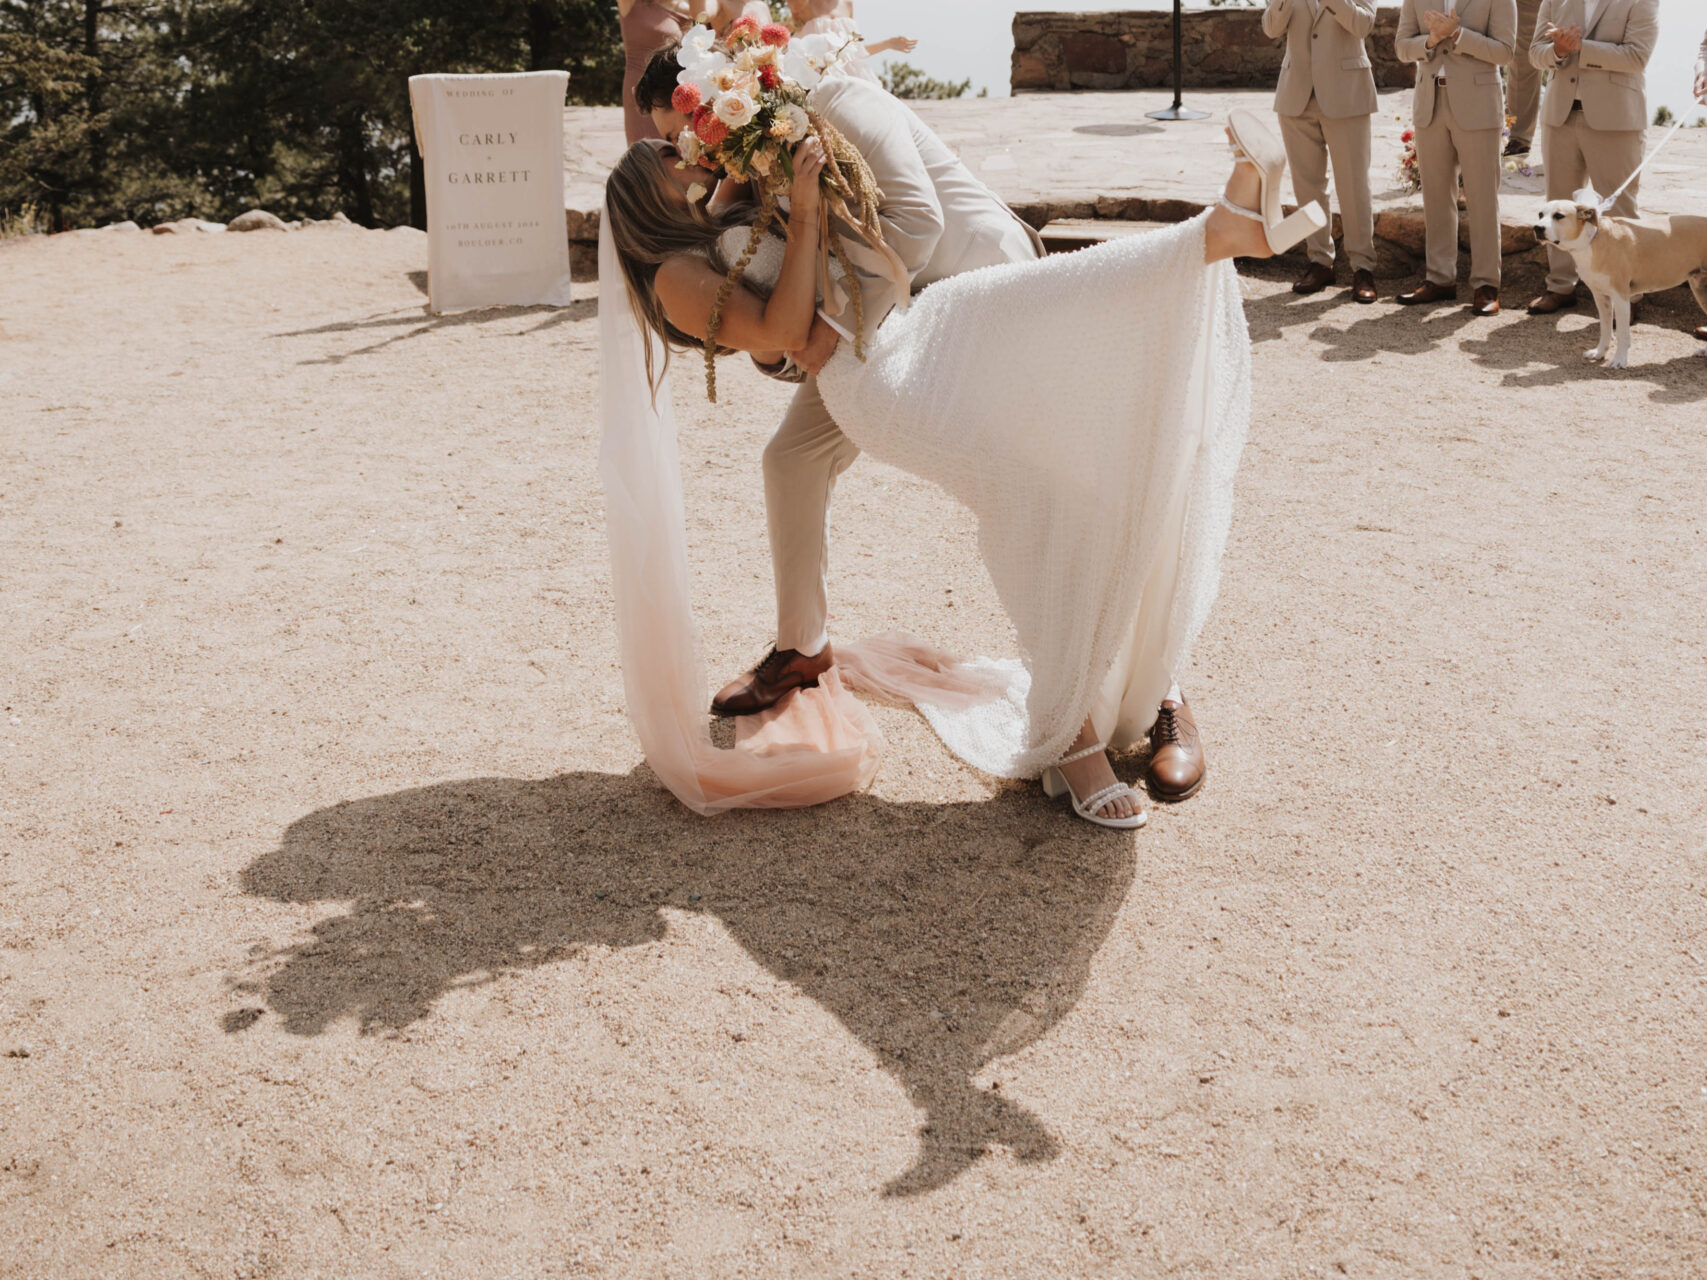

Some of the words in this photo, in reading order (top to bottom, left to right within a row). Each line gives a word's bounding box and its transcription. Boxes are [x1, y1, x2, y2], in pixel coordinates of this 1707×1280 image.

[446, 90, 495, 98] WEDDING
[502, 88, 515, 97] OF
[459, 131, 518, 146] CARLY
[448, 169, 532, 184] GARRETT
[473, 221, 513, 231] AUGUST
